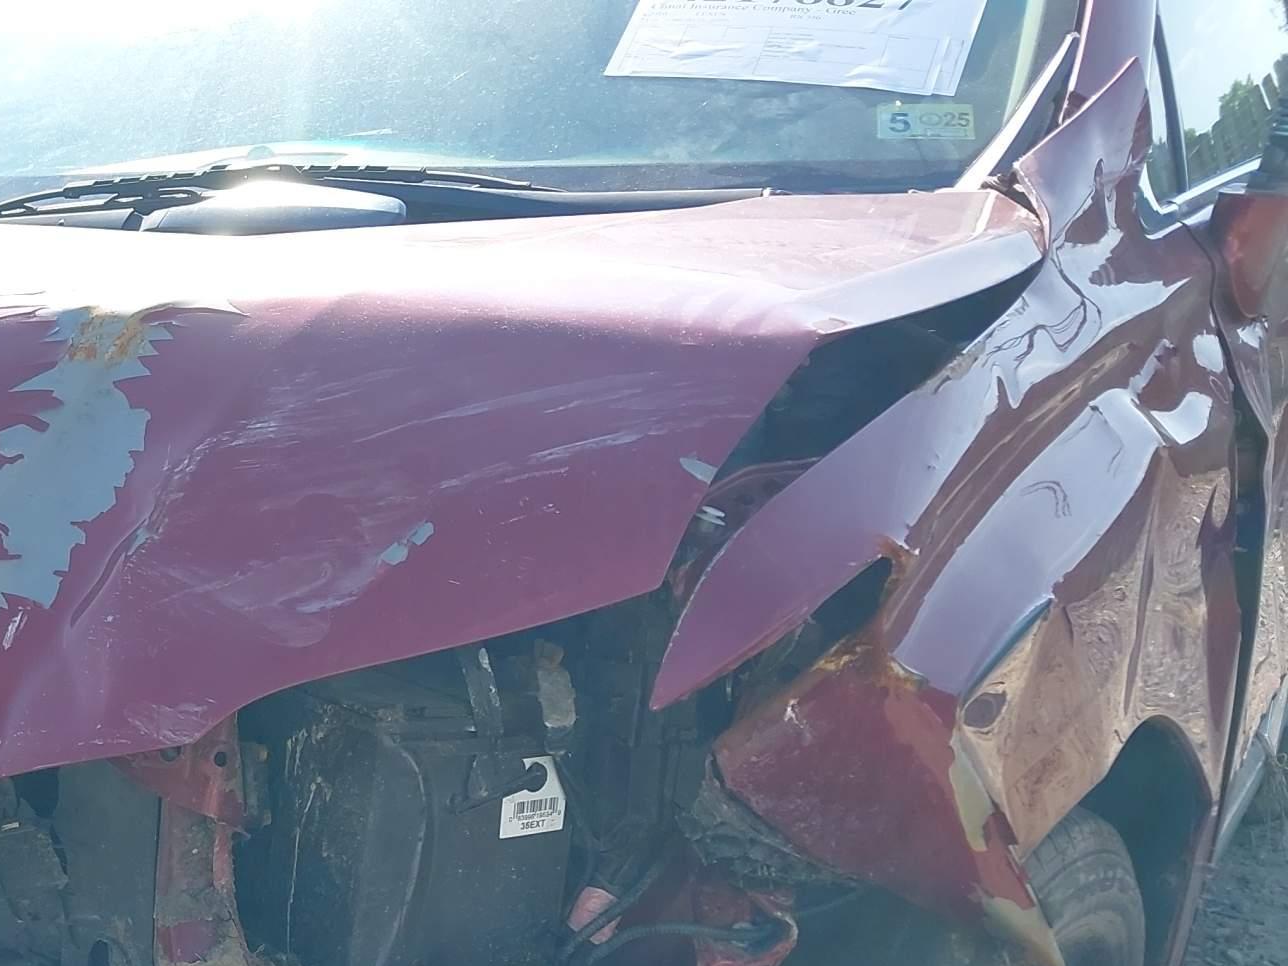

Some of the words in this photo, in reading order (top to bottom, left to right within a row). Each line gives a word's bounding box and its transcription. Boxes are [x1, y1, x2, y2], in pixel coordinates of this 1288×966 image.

[752, 4, 811, 14] Company
[889, 112, 911, 133] 5
[943, 111, 970, 127] 25
